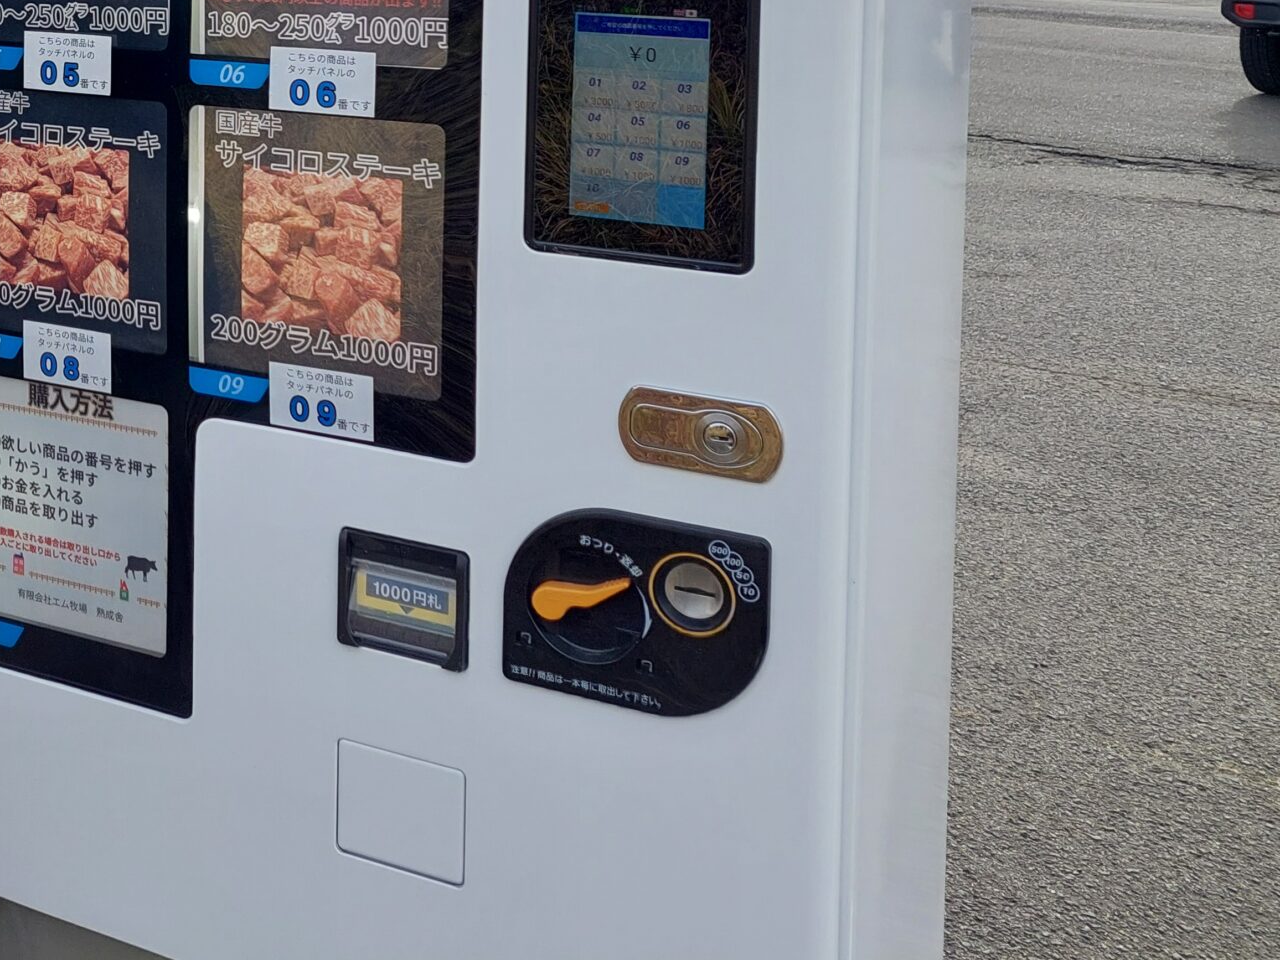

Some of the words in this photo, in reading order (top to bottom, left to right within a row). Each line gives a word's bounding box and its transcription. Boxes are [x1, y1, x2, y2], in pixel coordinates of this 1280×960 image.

[38, 36, 95, 48] こちらの商品は
[38, 48, 95, 59] タッチパネルの
[288, 52, 356, 66] こちらの商品は
[220, 64, 245, 84] 06
[288, 64, 356, 78] タッチパネルの
[588, 77, 602, 88] 01
[631, 80, 647, 91] 02
[677, 84, 692, 94] 03
[215, 109, 283, 139] 国産牛
[587, 112, 602, 123] 04
[630, 116, 646, 127] 05
[676, 120, 691, 131] 06
[215, 140, 442, 189] サイコロステーキ
[586, 147, 601, 158] 07
[629, 151, 644, 162] 08
[674, 155, 690, 166] 09
[38, 326, 95, 344] こちらの商品は
[38, 338, 95, 355] タッチパネルの
[210, 313, 439, 376] 200グラム1000円
[218, 374, 245, 395] 09
[286, 368, 354, 387] こちらの商品は
[286, 380, 354, 399] タッチパネルの
[28, 382, 114, 420] 購入方法
[711, 545, 728, 555] 500
[726, 557, 741, 567] 100
[736, 571, 750, 581] 50
[373, 580, 442, 610] 1000円札
[742, 587, 755, 596] 10
